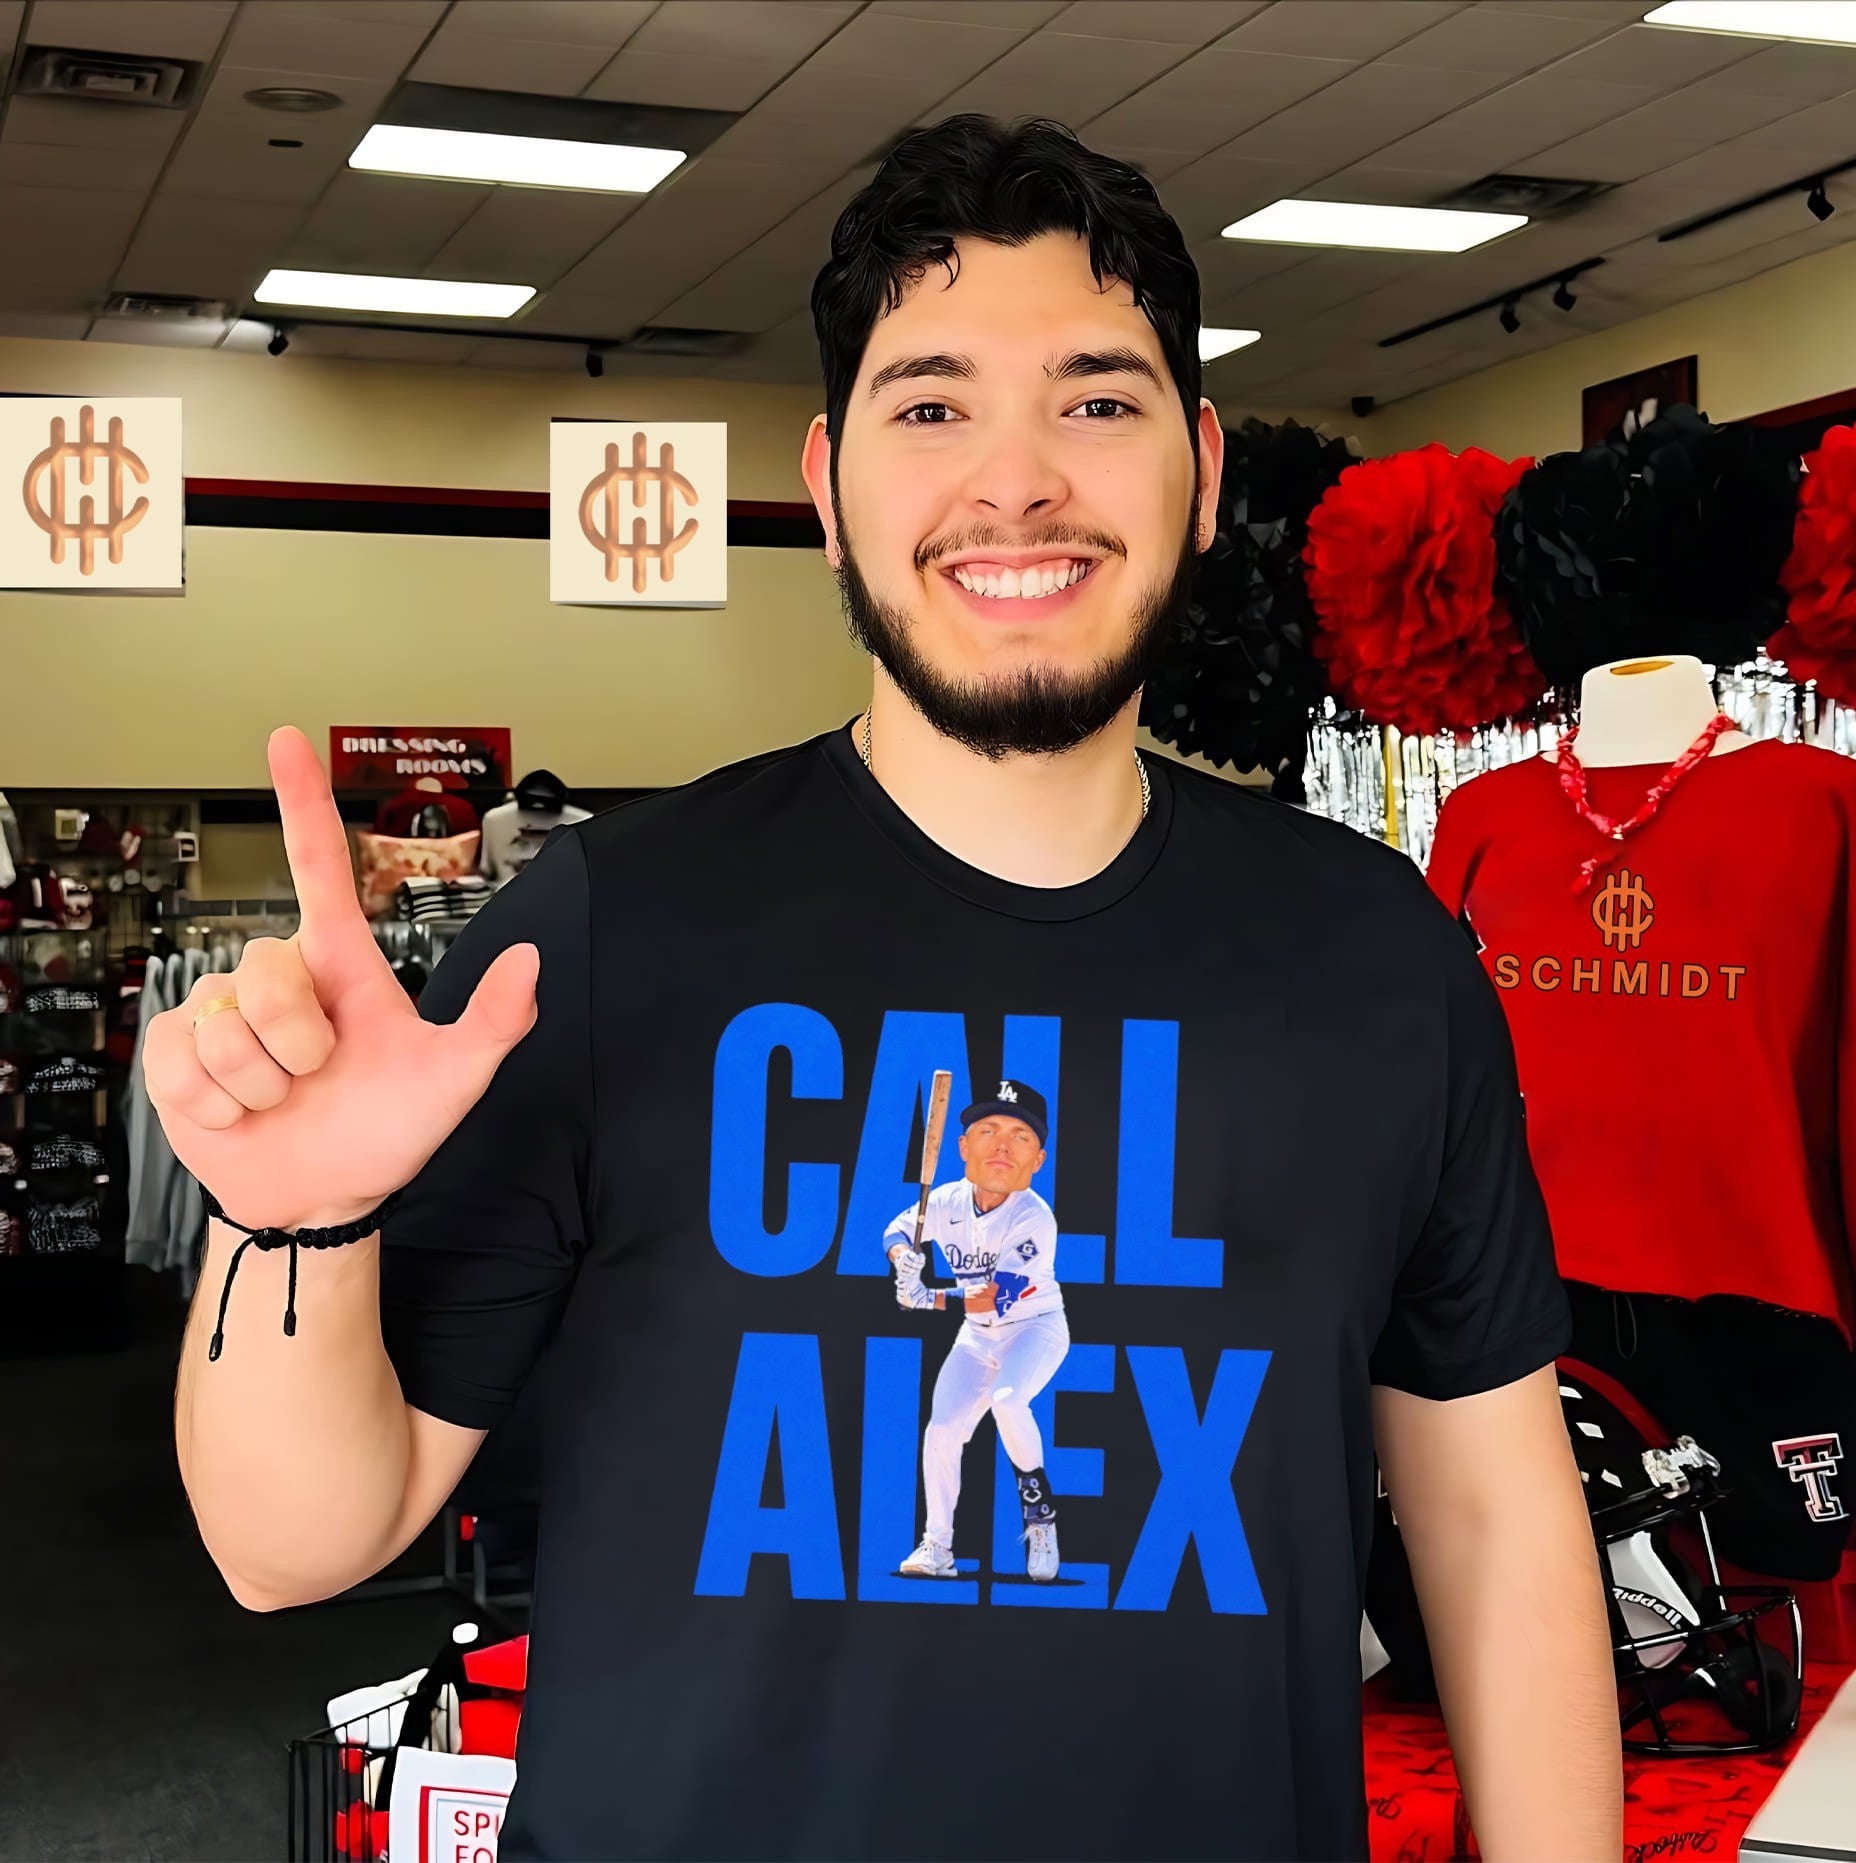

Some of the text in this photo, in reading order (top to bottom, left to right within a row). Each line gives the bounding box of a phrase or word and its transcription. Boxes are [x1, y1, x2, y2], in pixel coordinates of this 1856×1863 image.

[1494, 954, 1747, 1000] SCHMIDT
[709, 1002, 1225, 1289] CALL
[694, 1332, 1274, 1616] ALEX
